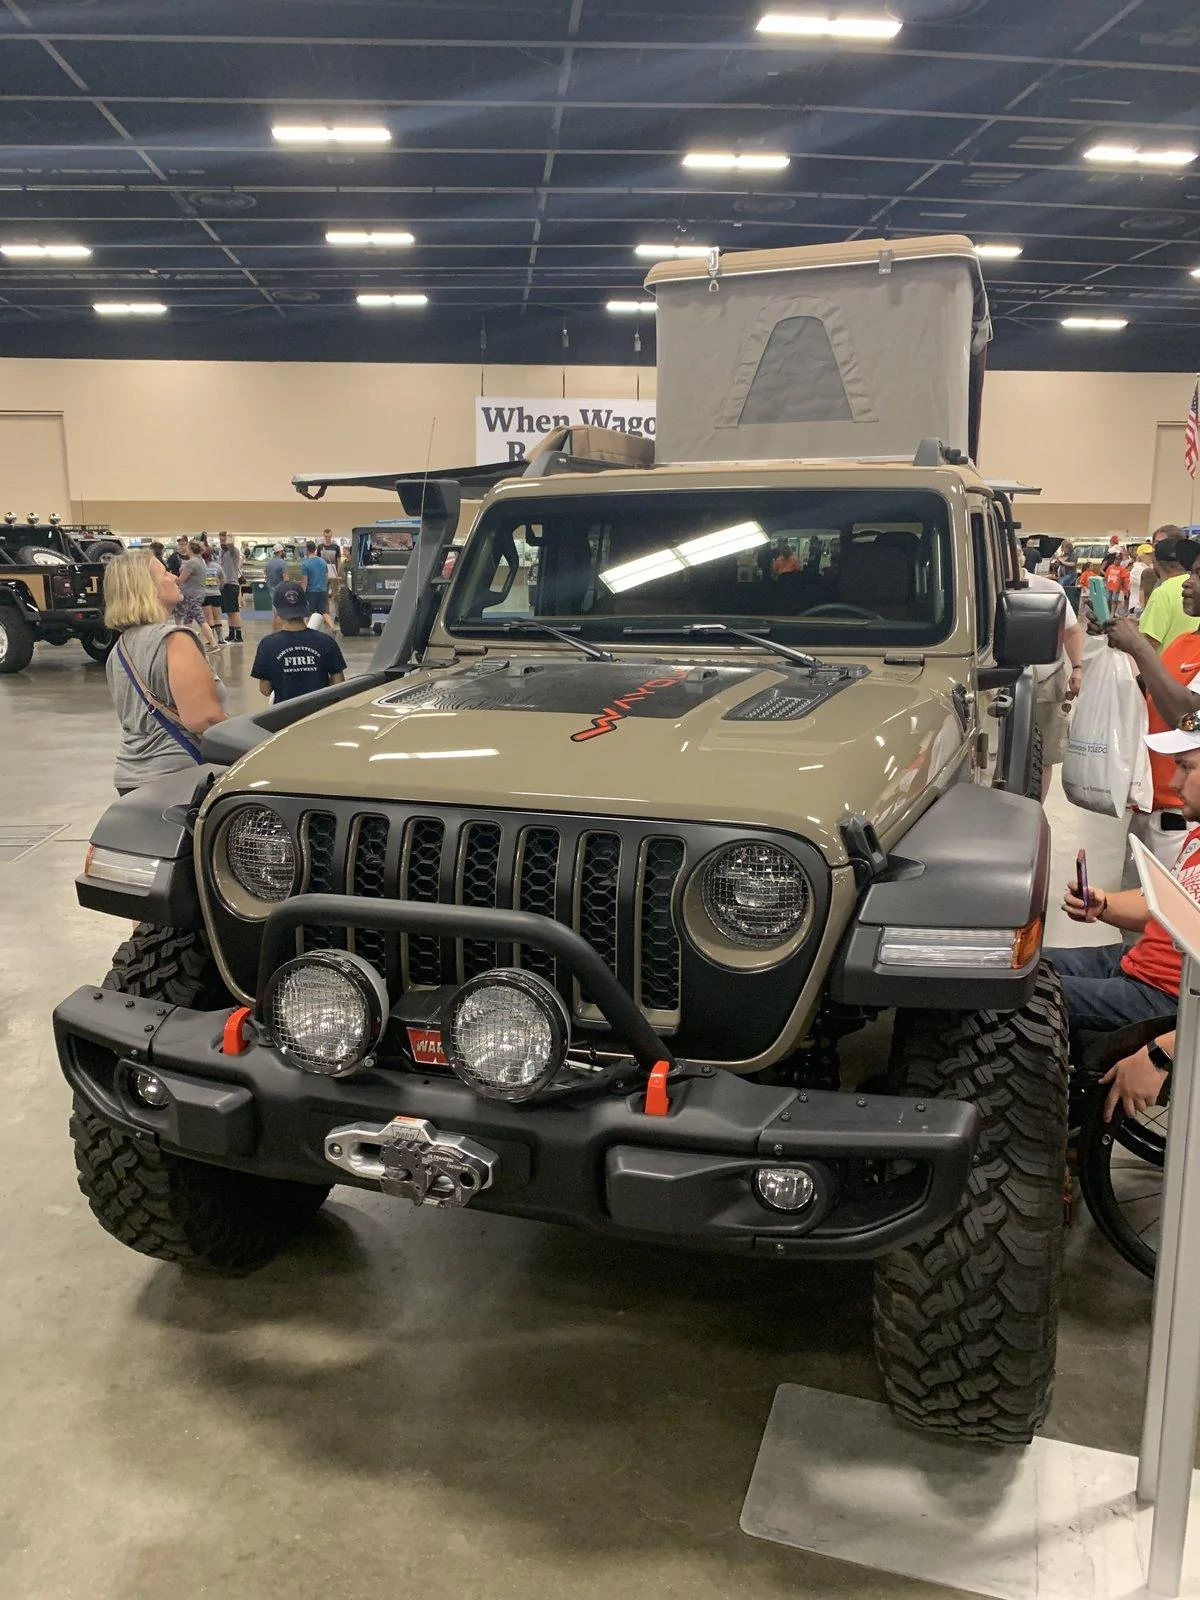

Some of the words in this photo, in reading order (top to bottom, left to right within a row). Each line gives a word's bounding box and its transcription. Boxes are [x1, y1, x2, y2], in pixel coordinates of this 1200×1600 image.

[481, 406, 570, 433] When
[276, 646, 294, 661] NORTH
[284, 655, 315, 667] FIRE
